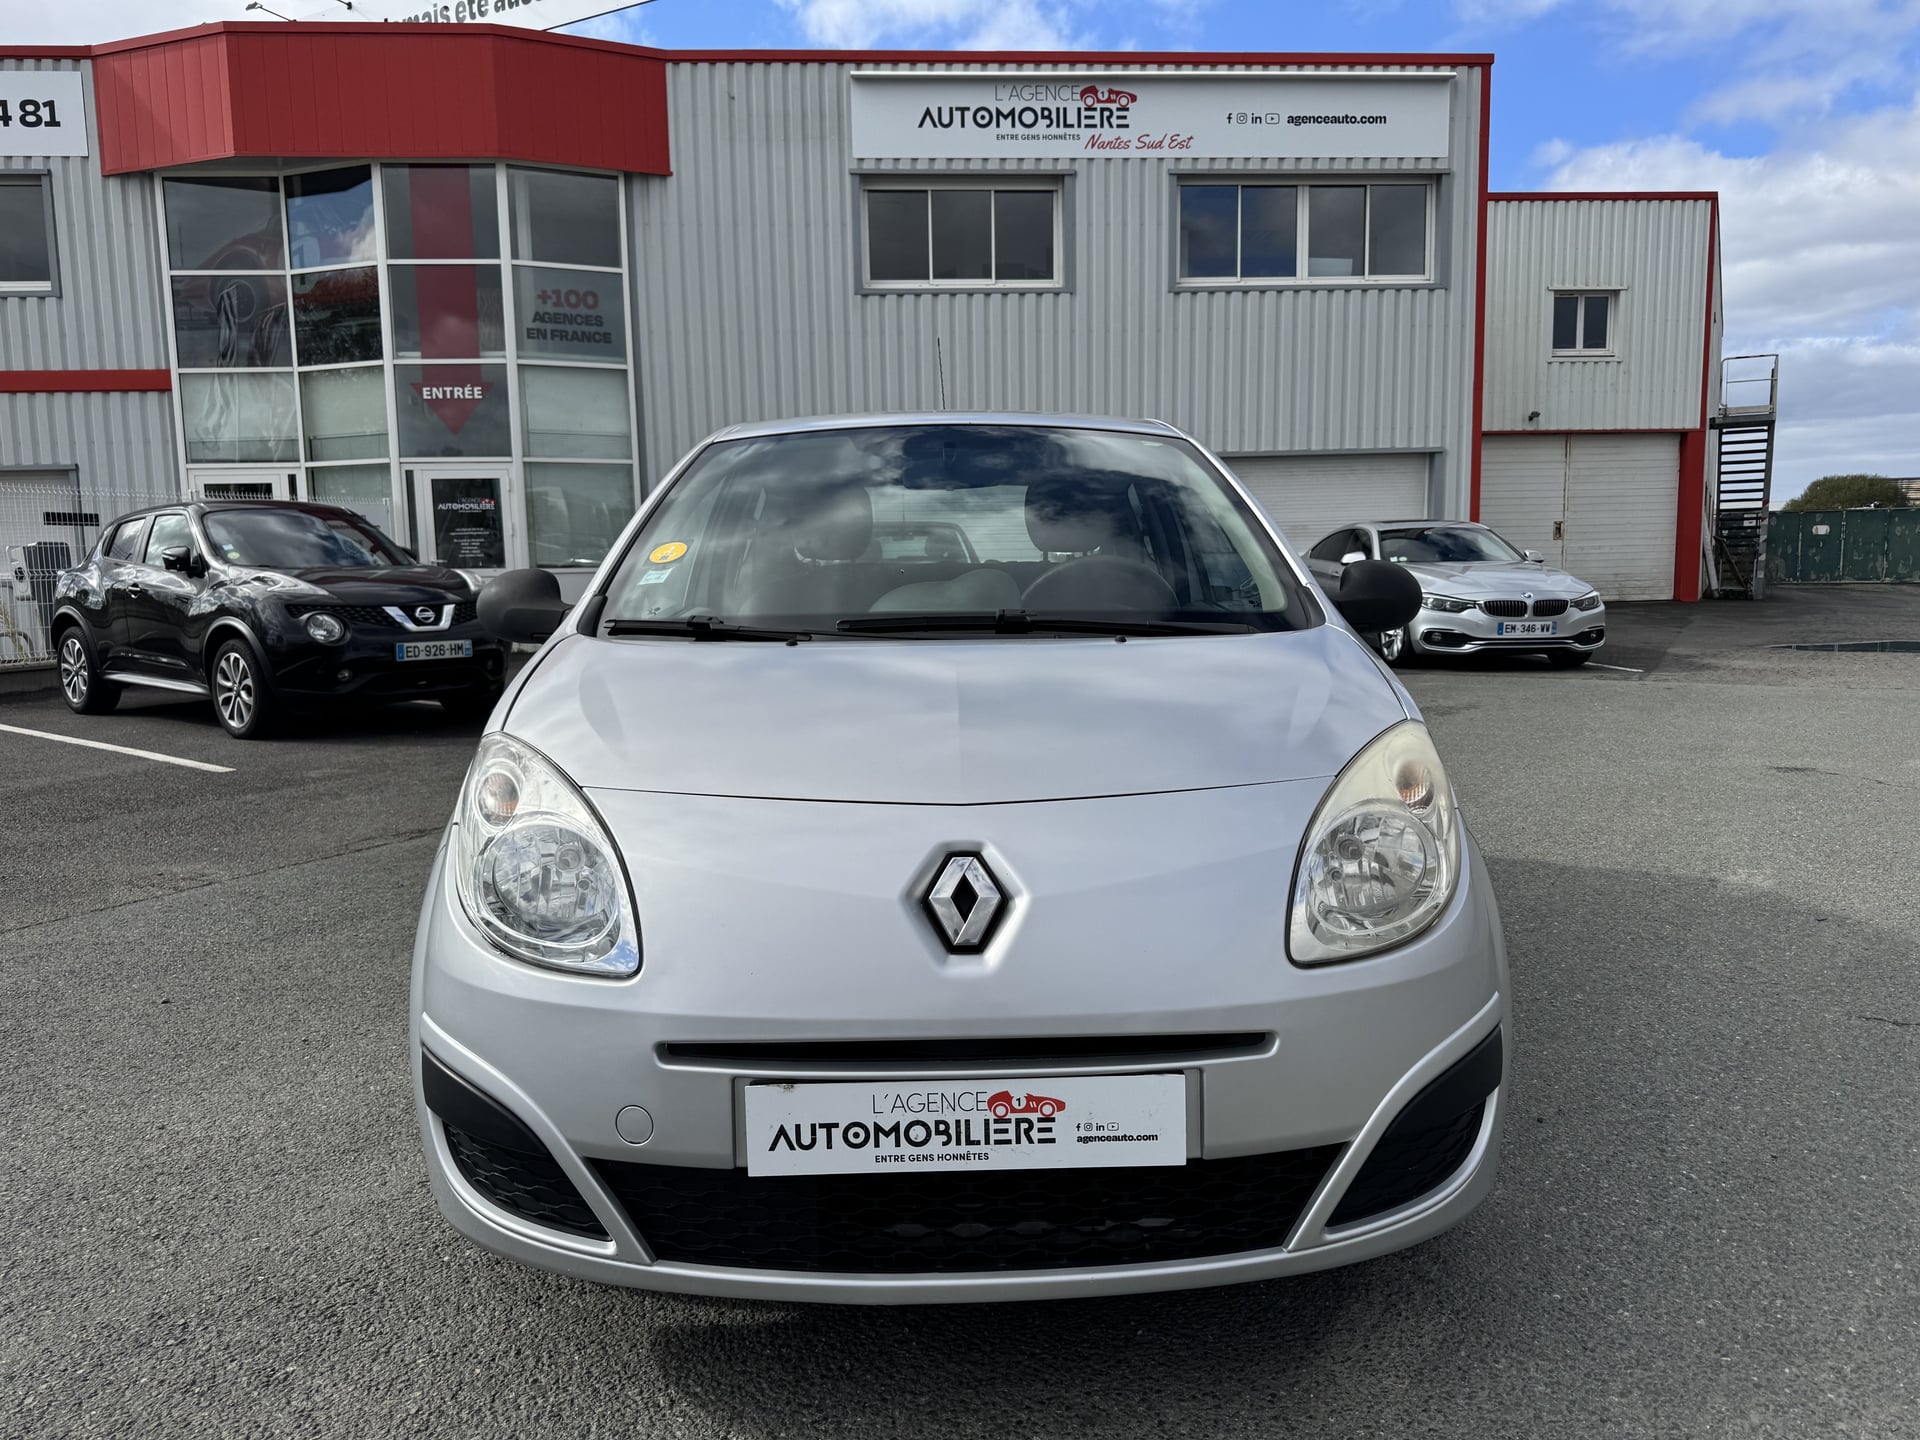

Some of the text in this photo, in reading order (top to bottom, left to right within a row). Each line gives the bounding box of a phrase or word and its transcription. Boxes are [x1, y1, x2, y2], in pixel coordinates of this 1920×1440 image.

[994, 84, 1080, 101] L'AGENCE
[19, 99, 61, 128] 81
[1287, 113, 1387, 126] agenceauto.com
[996, 131, 1081, 141] ENTRE GENS HONNÊTES
[1084, 133, 1195, 150] Nantes Sud Est
[537, 288, 599, 310] +100
[532, 310, 604, 328] AGENCES
[526, 327, 613, 345] EN FRANCE
[422, 383, 483, 400] ENTRÉE
[872, 1091, 988, 1114] L'AGENCE
[1076, 1134, 1159, 1144] agenceauto.com
[875, 1150, 990, 1163] ENTRE GENS HONNÊTES
